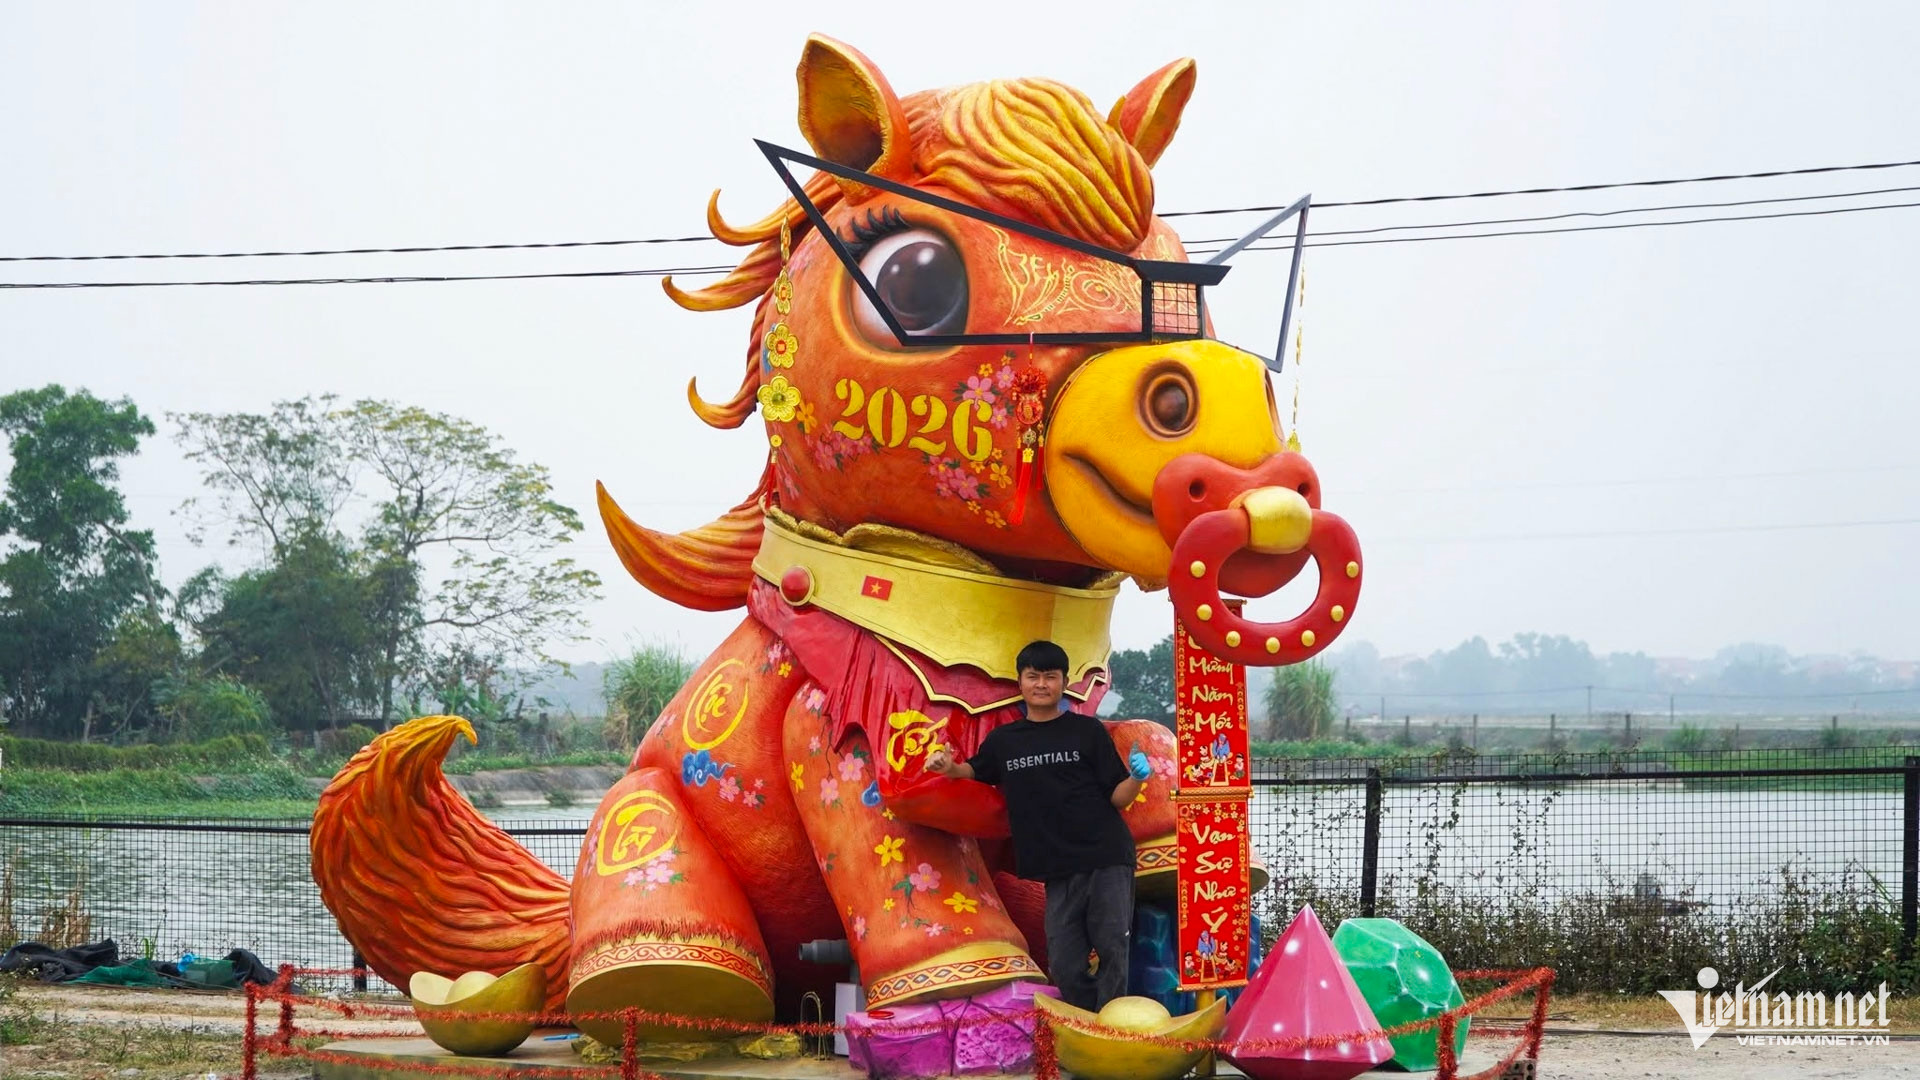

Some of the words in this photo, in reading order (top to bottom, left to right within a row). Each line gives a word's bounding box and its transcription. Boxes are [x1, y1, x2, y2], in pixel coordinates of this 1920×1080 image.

[833, 378, 993, 462] 2026
[1188, 656, 1235, 685] Mừng
[1192, 684, 1234, 707] Năm
[1194, 711, 1234, 735] Mới
[1006, 750, 1081, 772] ESSENTIALS
[1191, 822, 1236, 845] Vạn
[1194, 850, 1234, 874] Sự
[1193, 880, 1237, 904] Như
[1201, 906, 1228, 934] Ý
